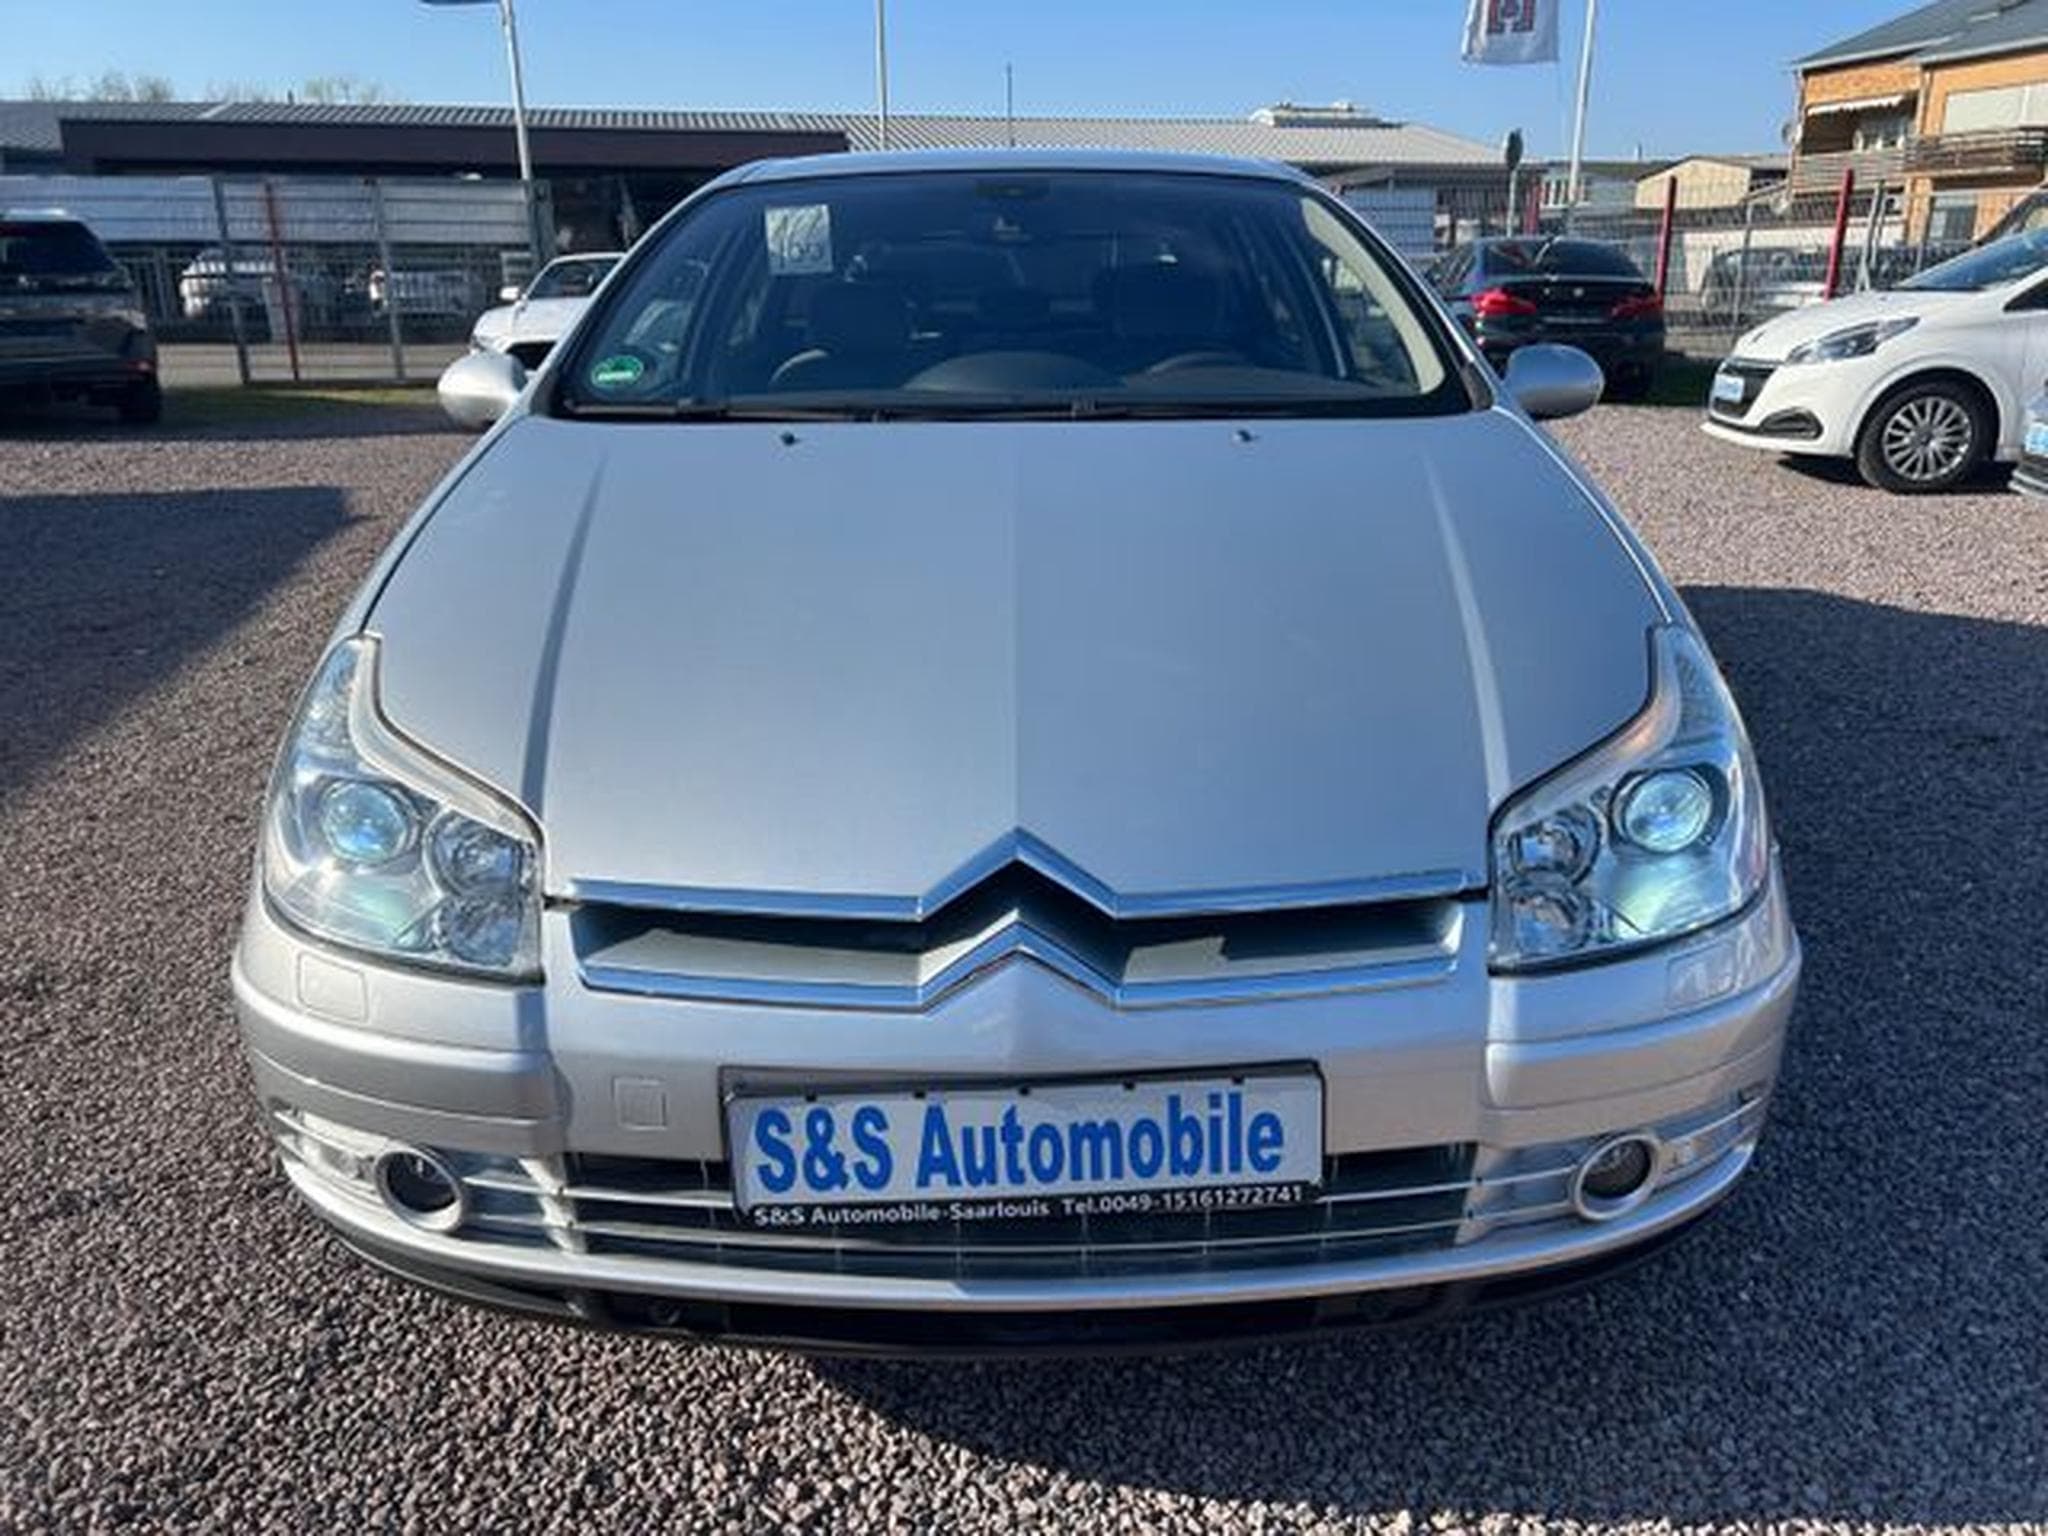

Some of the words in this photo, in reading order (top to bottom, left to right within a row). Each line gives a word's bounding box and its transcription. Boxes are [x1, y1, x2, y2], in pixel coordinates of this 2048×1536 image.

[755, 1106, 893, 1193] S&S
[915, 1092, 1284, 1188] Automobile
[753, 1207, 806, 1227] S&S
